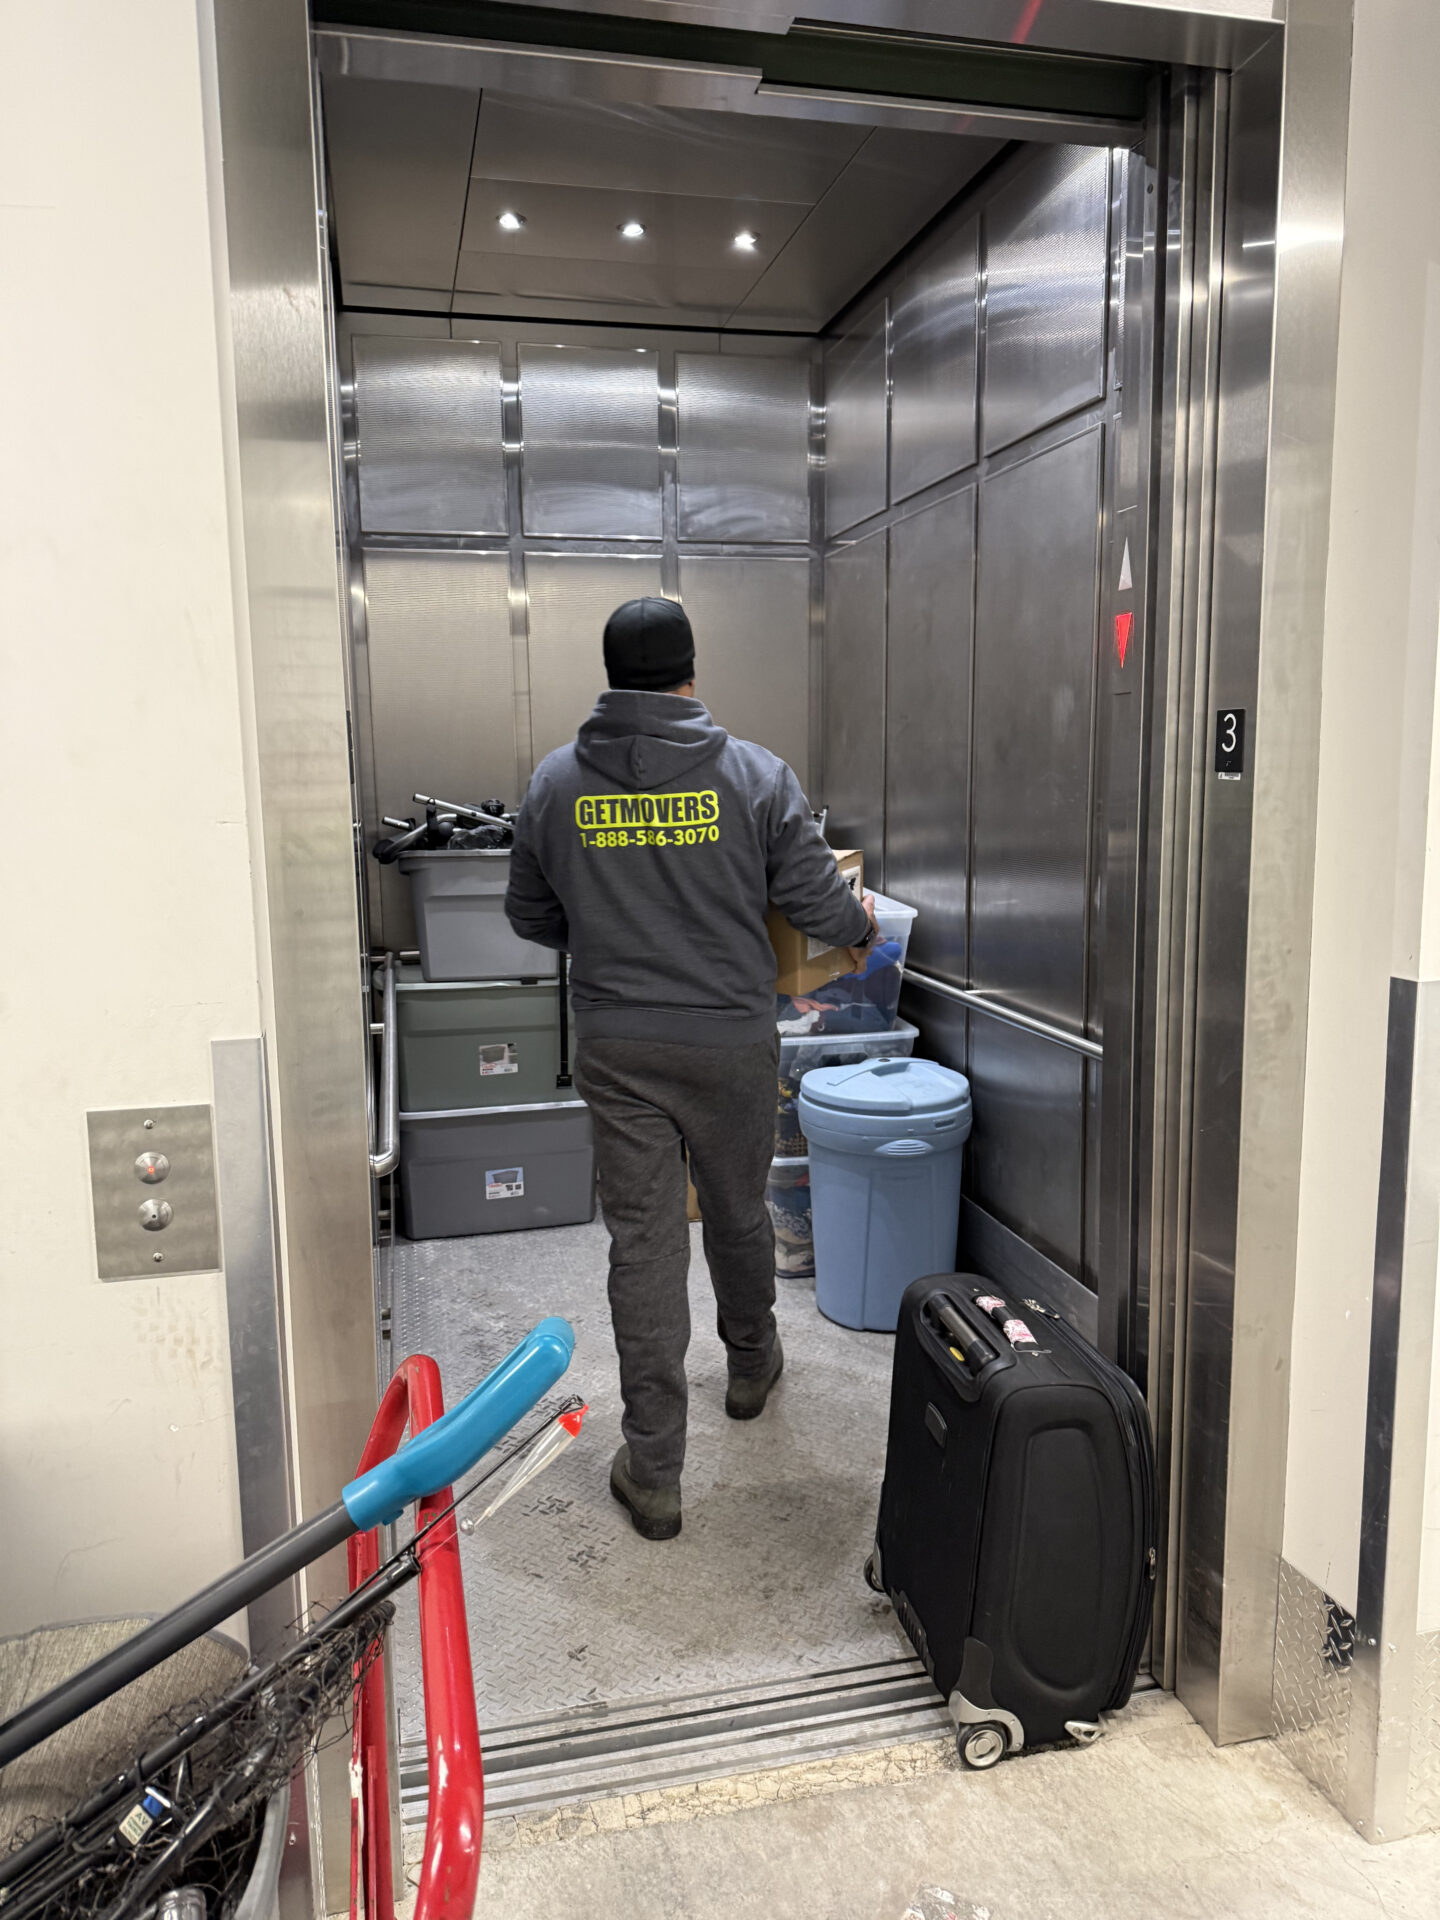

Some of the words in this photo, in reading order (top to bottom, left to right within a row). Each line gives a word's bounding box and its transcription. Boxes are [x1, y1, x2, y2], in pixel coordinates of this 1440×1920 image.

[1222, 713, 1237, 753] 3
[578, 792, 718, 827] GETMOVERS
[579, 825, 720, 849] 1-888-586-3070
